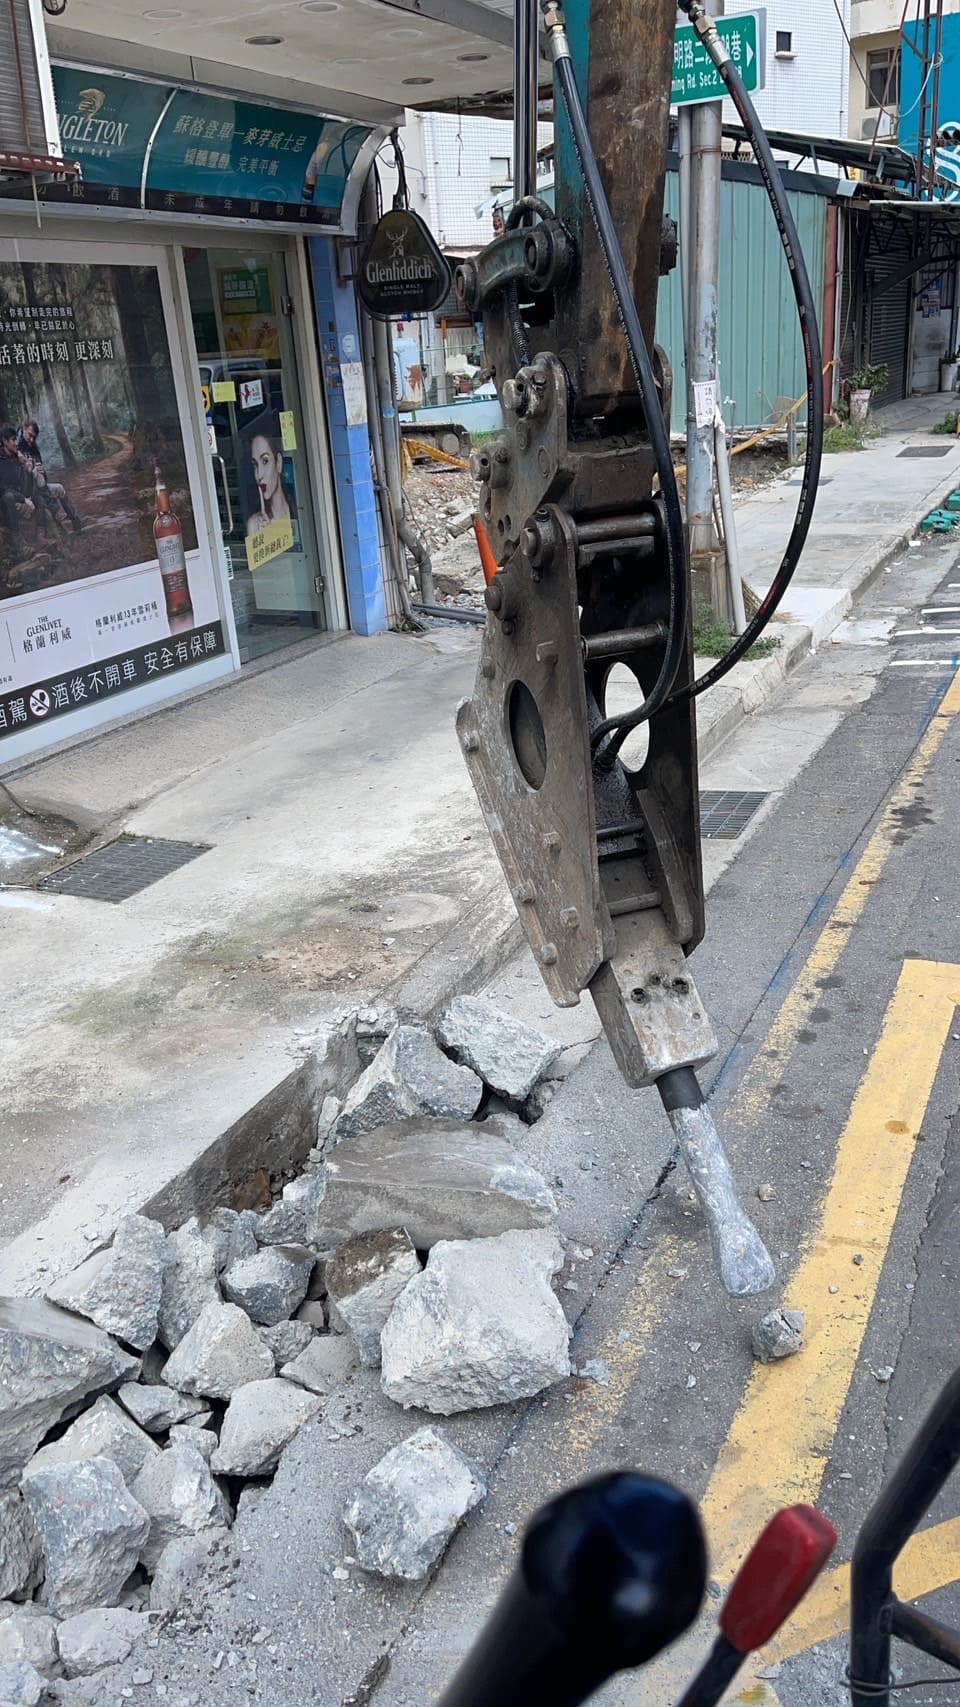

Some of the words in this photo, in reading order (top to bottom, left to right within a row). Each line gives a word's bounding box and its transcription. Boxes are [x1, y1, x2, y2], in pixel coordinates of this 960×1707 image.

[173, 114, 307, 153] 蘇格登單一麥芽威士忌
[237, 156, 281, 177] 完美平衡
[366, 258, 432, 284] Glenfiddich
[0, 341, 70, 367] 活著的時刻
[74, 339, 114, 361] 更深刻
[26, 618, 63, 638] GLENLIVET
[37, 615, 49, 625] THE
[22, 627, 73, 654] 格蘭利威
[51, 657, 138, 709] 酒後不開車
[144, 630, 217, 675] 安全有保障
